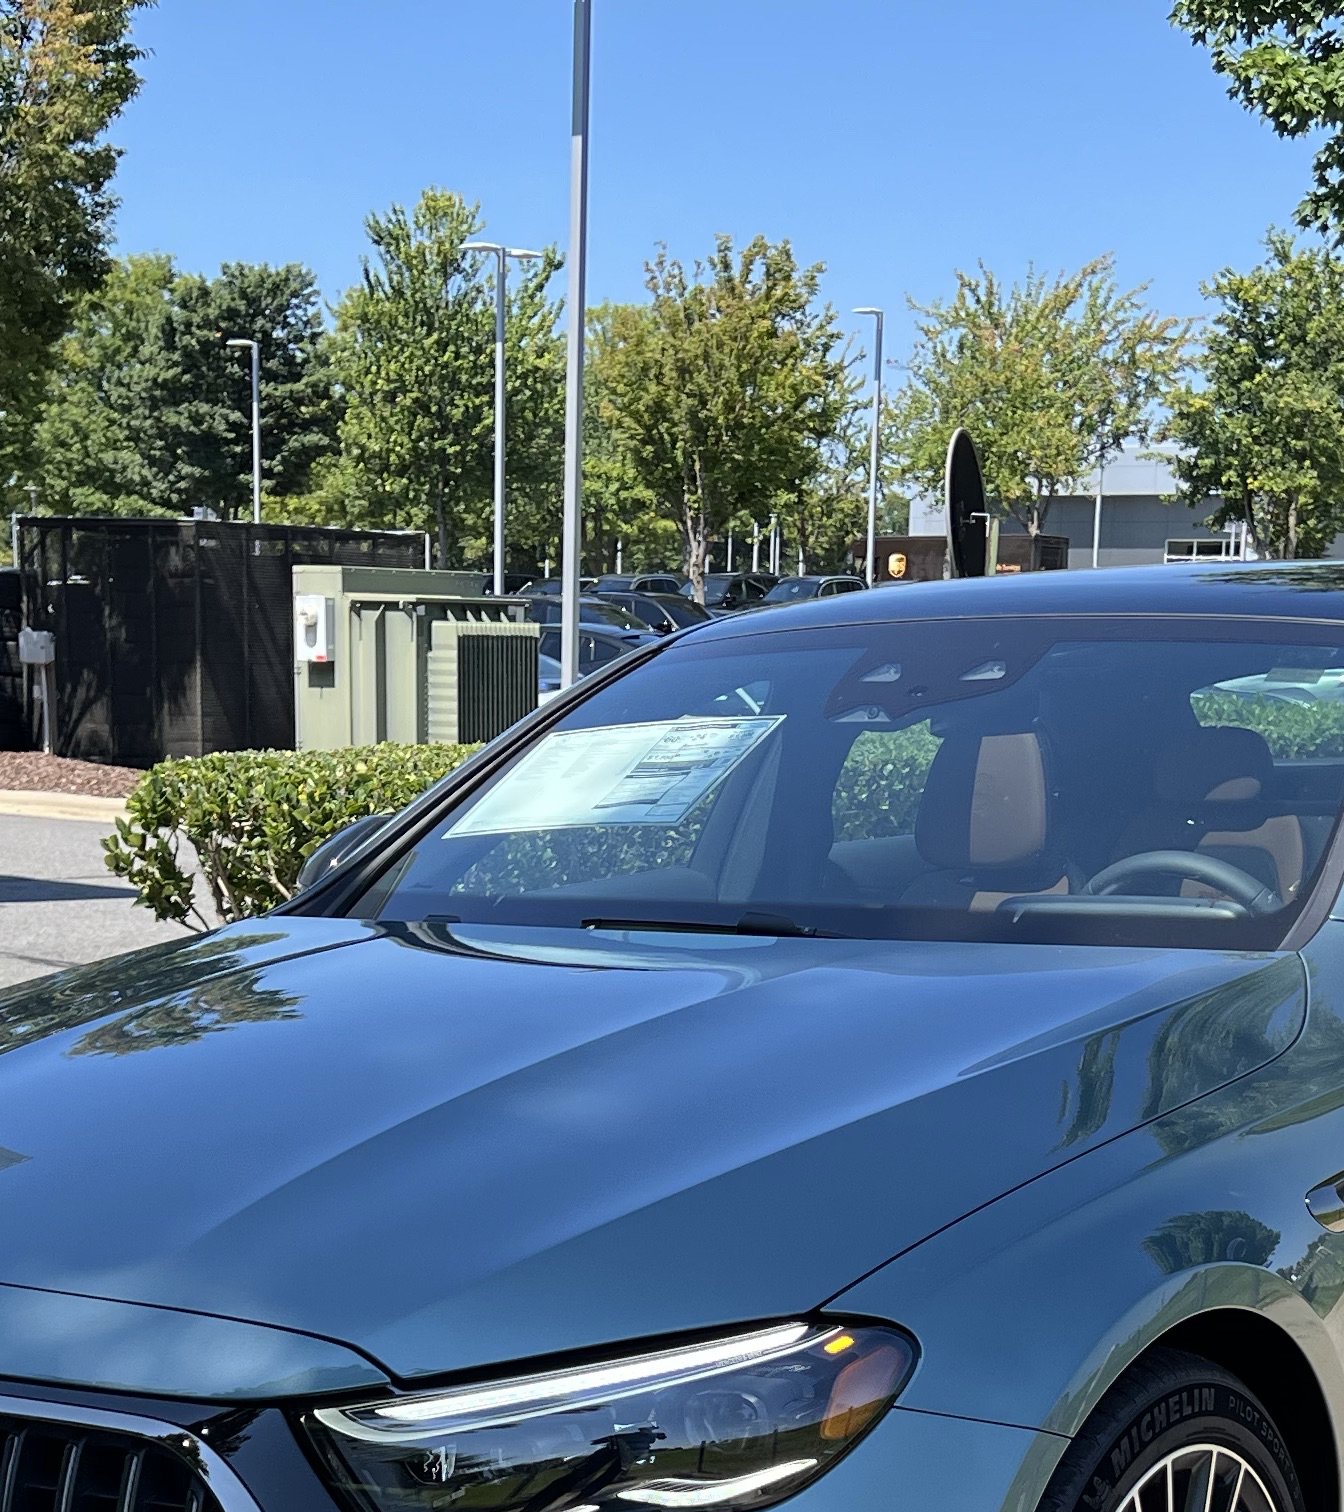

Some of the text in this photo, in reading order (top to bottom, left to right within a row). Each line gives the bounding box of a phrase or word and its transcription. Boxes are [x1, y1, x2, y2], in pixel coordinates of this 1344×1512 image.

[1110, 1387, 1291, 1476] MICHELIN PILOT SPORT
